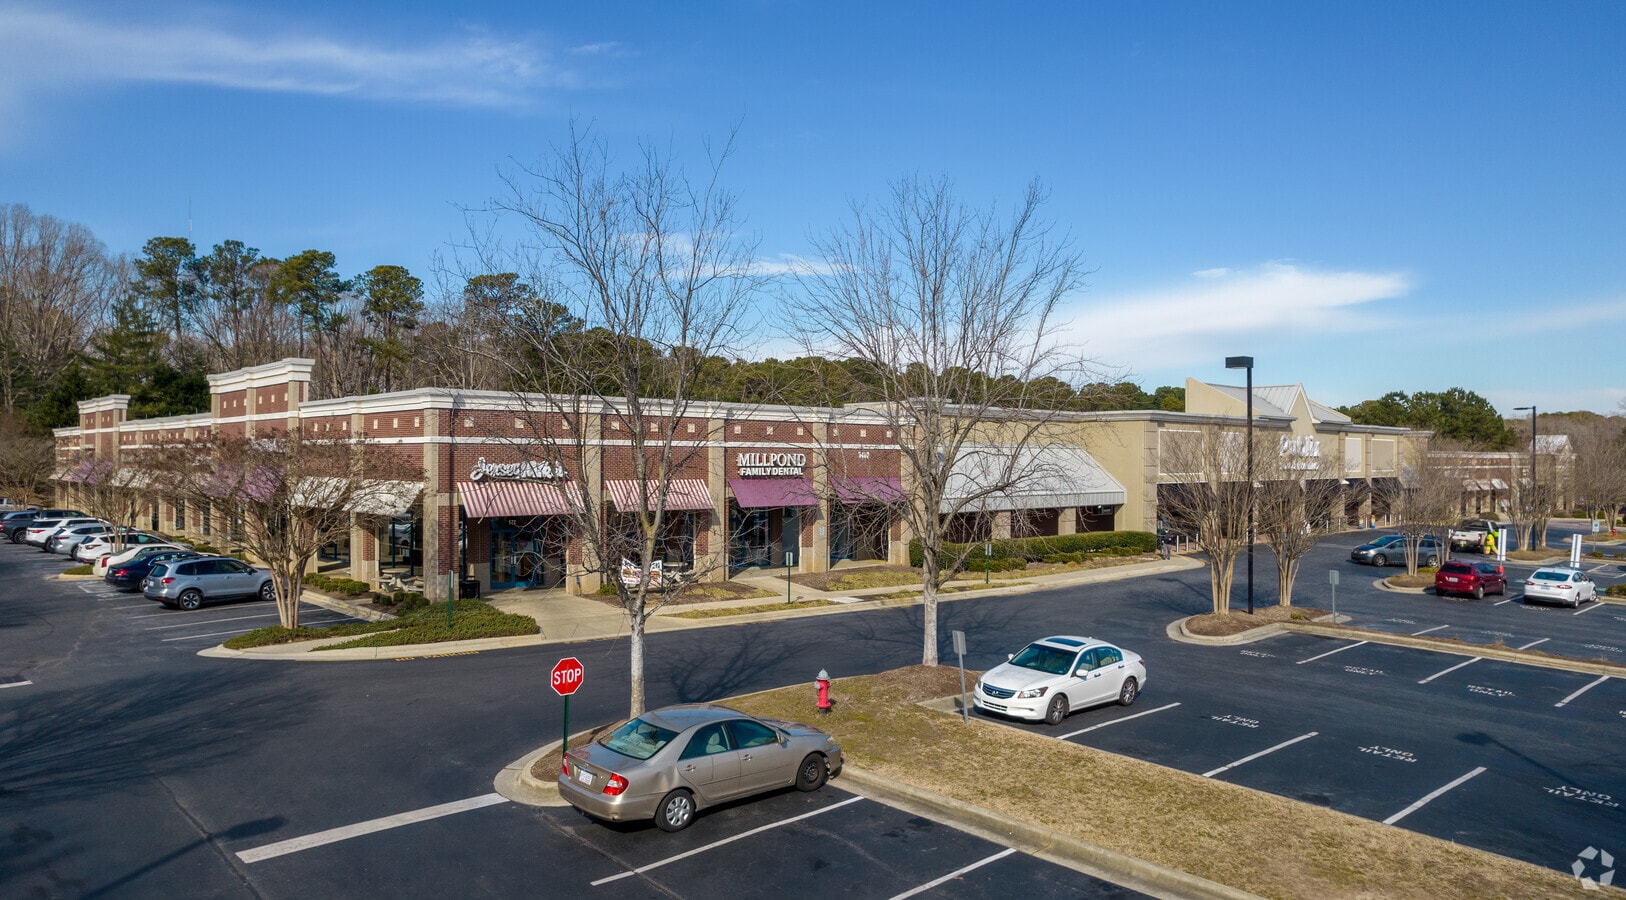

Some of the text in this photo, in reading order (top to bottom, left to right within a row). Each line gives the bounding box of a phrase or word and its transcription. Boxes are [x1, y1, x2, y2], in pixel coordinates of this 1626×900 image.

[737, 453, 806, 467] MILLPOND
[740, 467, 804, 476] FAMILY DENTAL
[553, 668, 582, 685] STOP
[1358, 746, 1417, 763] RETAIL
[1369, 745, 1414, 757] ONLY
[1543, 786, 1620, 808] RETAIL
[1556, 785, 1612, 800] ONLY
